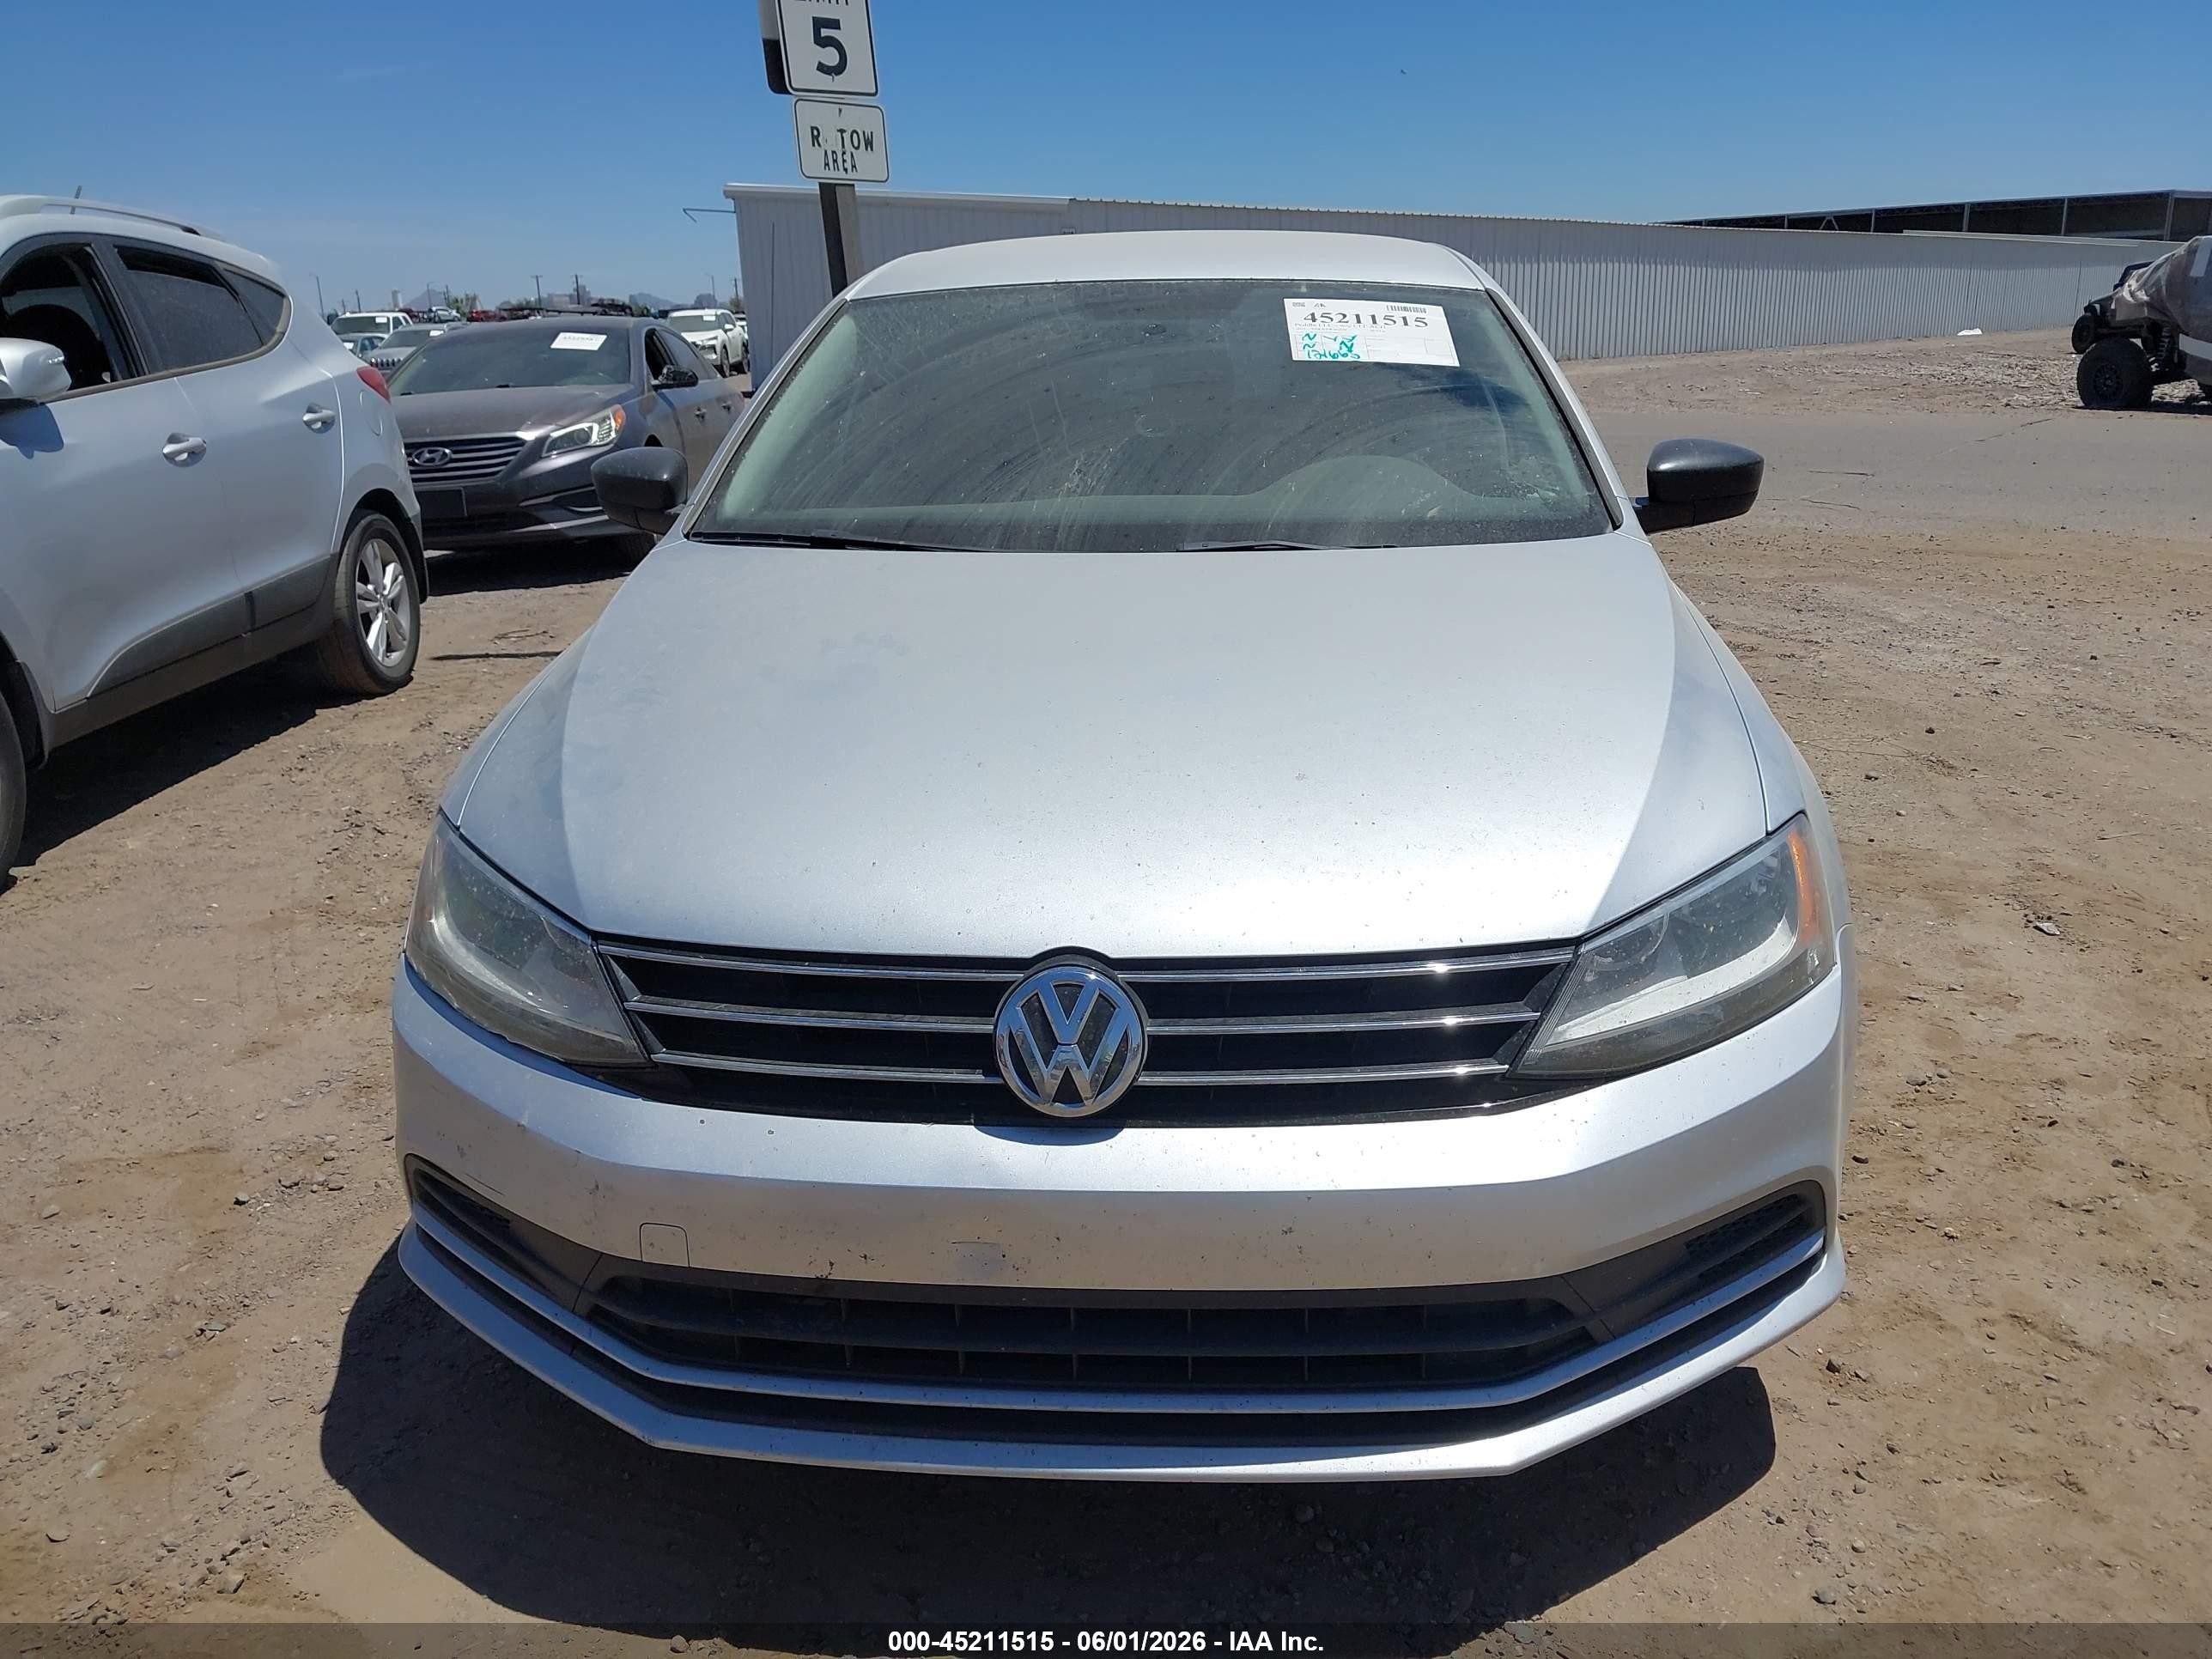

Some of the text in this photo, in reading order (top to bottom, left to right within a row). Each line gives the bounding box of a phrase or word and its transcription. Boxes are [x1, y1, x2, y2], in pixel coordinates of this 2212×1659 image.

[811, 15, 848, 77] 5
[836, 128, 875, 153] TOW
[823, 149, 859, 175] AREA
[1304, 311, 1429, 328] 45211515
